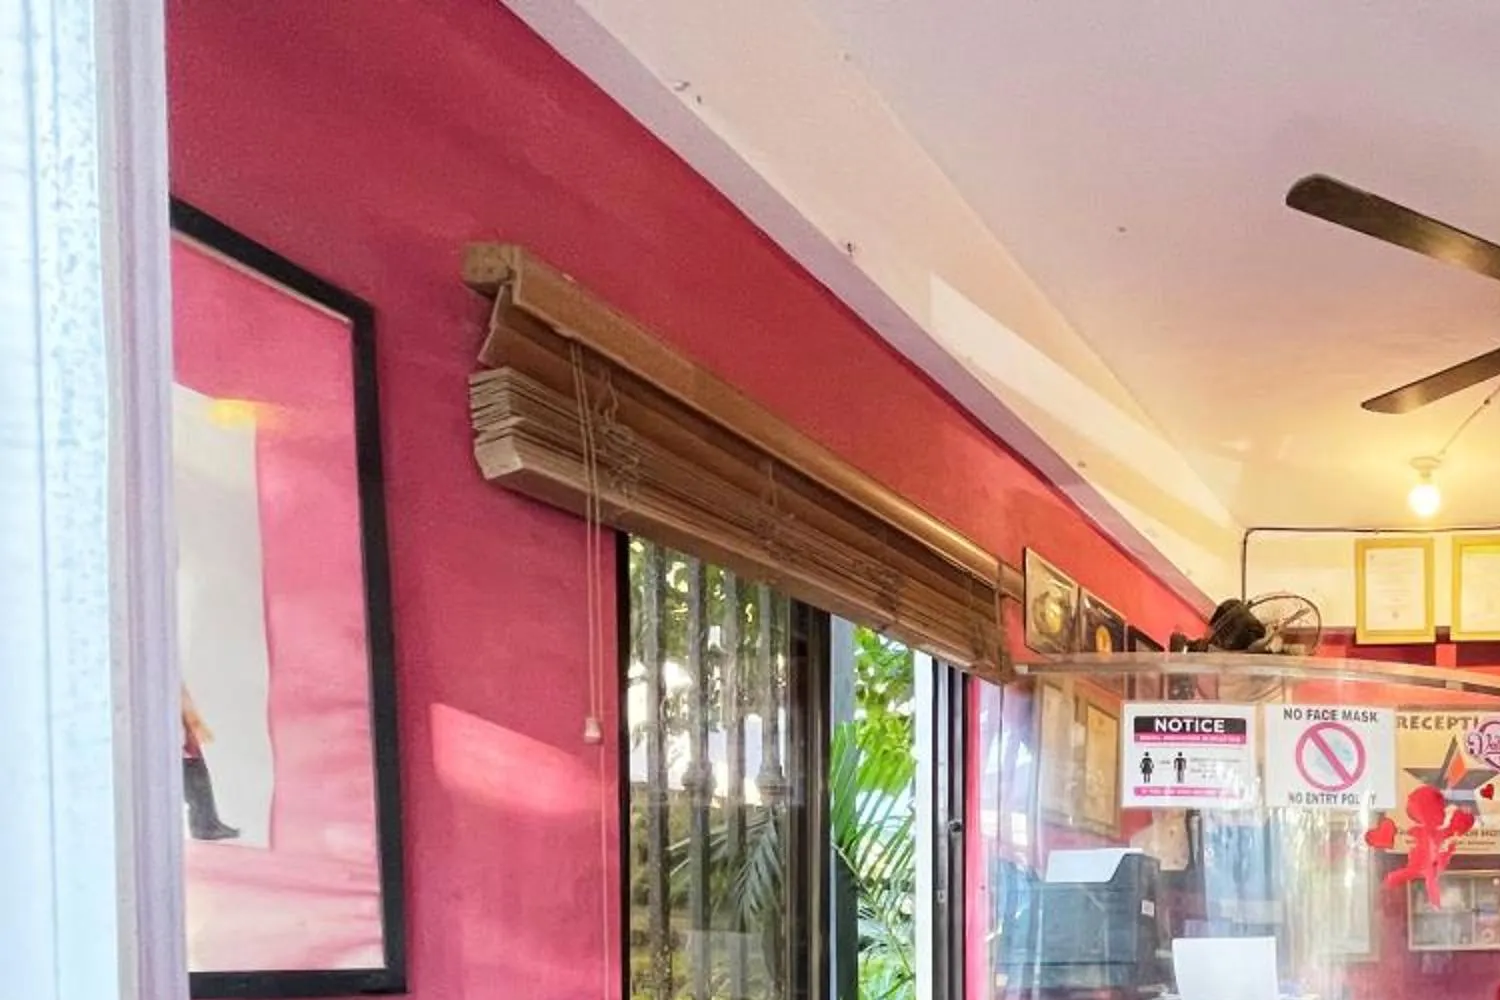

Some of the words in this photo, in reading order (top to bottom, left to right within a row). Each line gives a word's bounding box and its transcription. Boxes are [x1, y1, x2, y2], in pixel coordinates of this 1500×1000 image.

[1283, 708, 1303, 721] NO
[1306, 709, 1338, 721] FACE
[1342, 710, 1379, 722] MASK
[1154, 717, 1225, 733] NOTICE
[1396, 715, 1479, 731] RECEPTI
[1288, 792, 1303, 805] NO
[1305, 792, 1338, 805] ENTRY
[1341, 793, 1377, 805] POLY
